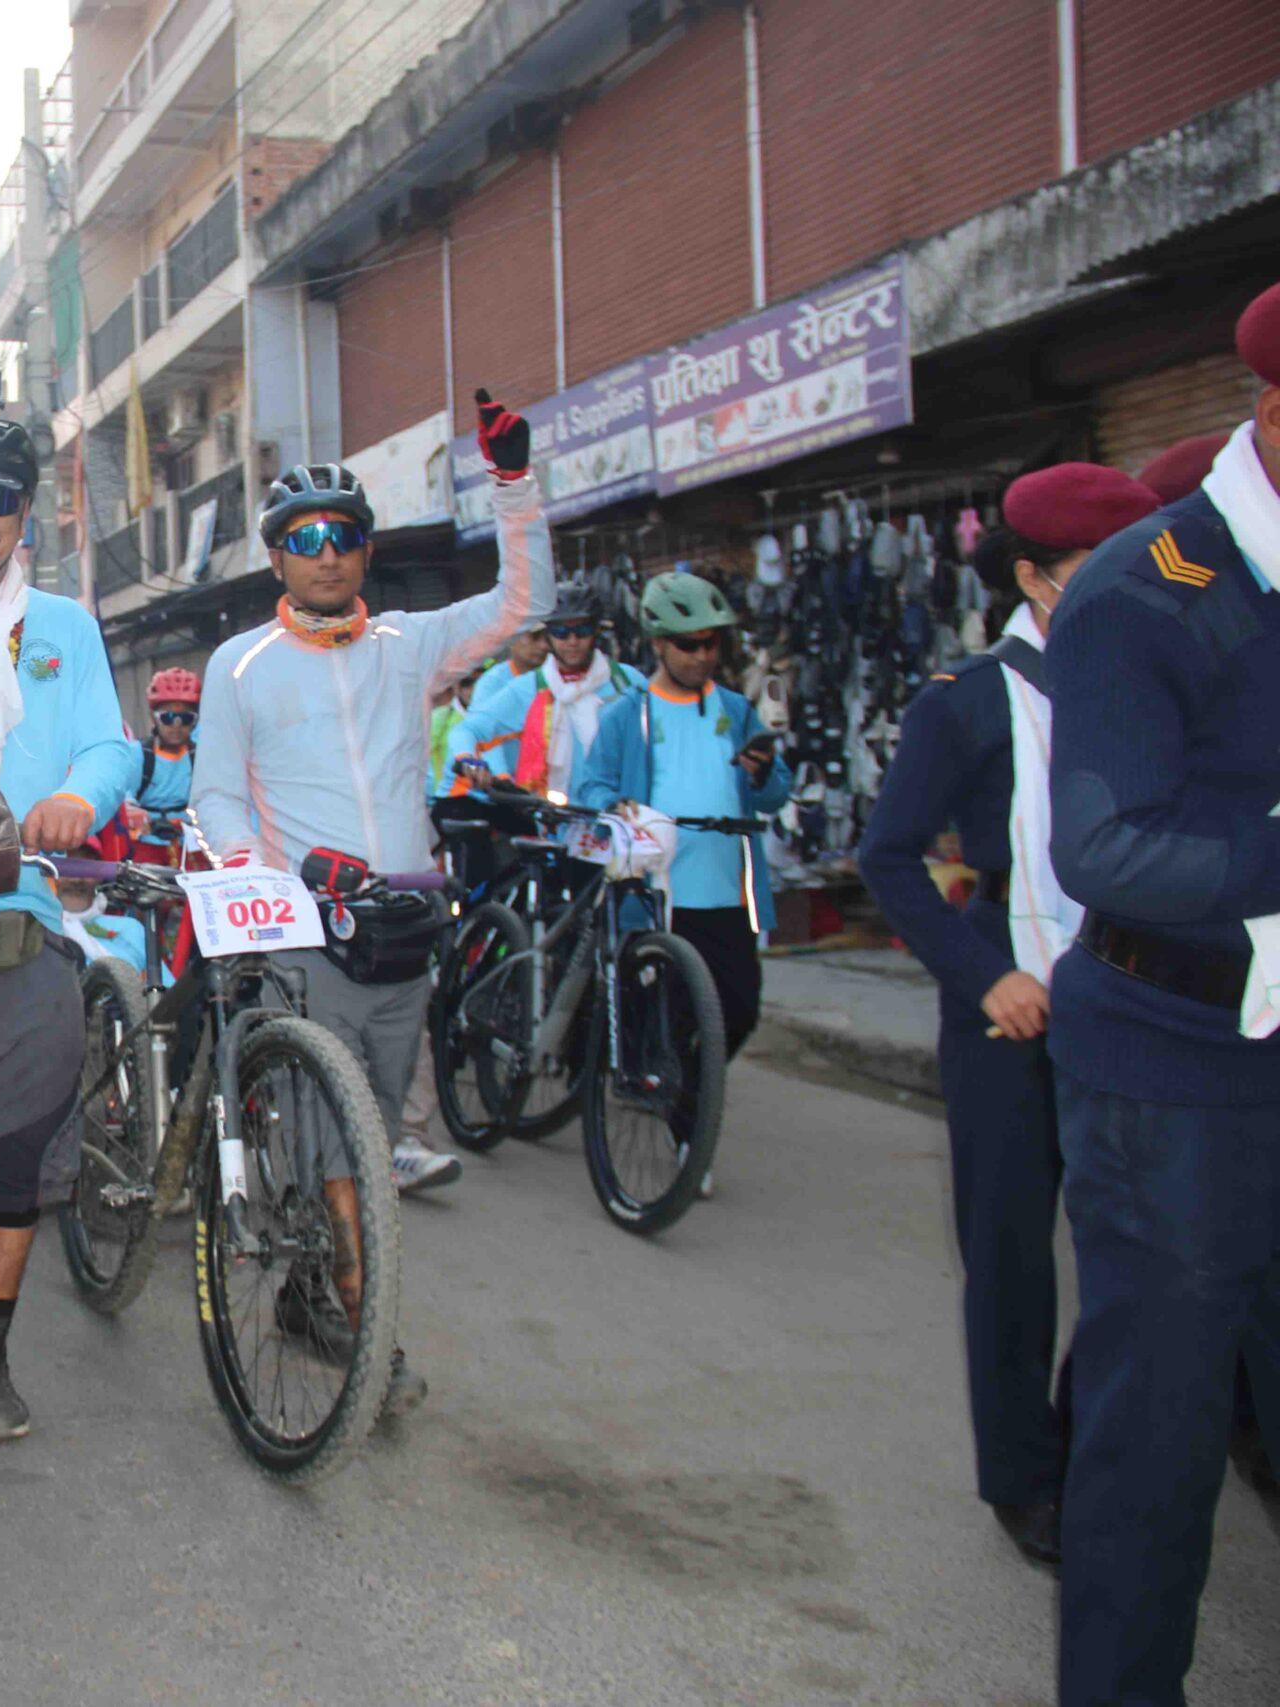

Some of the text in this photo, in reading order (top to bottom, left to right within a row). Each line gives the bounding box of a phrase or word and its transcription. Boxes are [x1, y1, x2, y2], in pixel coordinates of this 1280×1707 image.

[746, 328, 785, 384] शु
[226, 898, 296, 928] 002
[195, 1219, 213, 1324] MAXXIS
